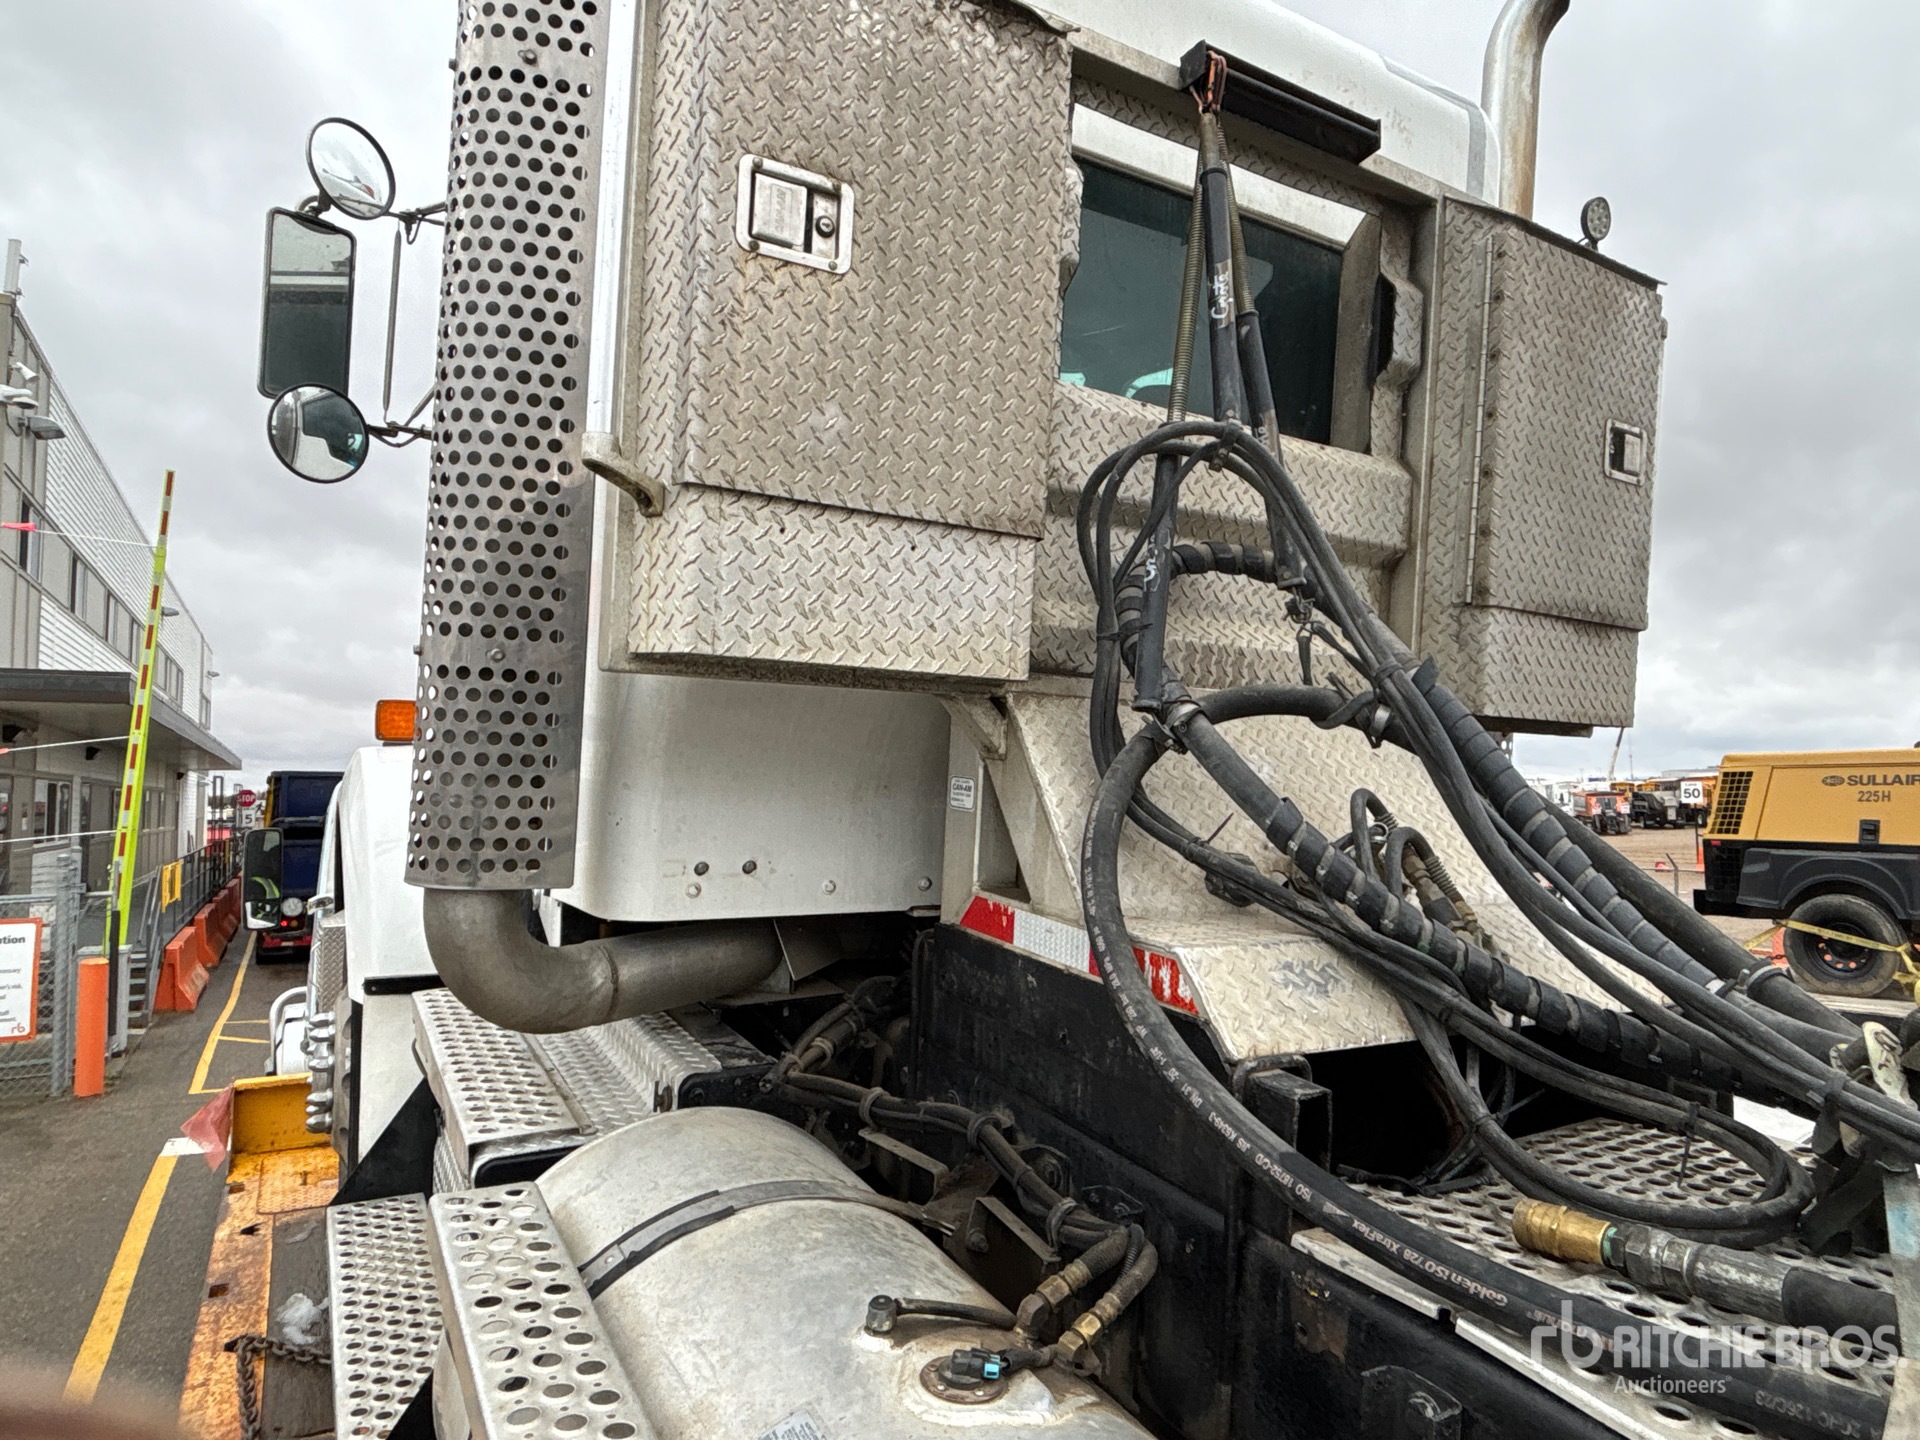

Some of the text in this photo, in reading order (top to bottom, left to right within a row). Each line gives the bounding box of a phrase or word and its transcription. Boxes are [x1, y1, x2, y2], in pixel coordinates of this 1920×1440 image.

[1847, 775, 1920, 786] SULLAIR
[1684, 788, 1700, 798] 50
[245, 814, 253, 824] 5
[1352, 1219, 1400, 1254] XtraFlex
